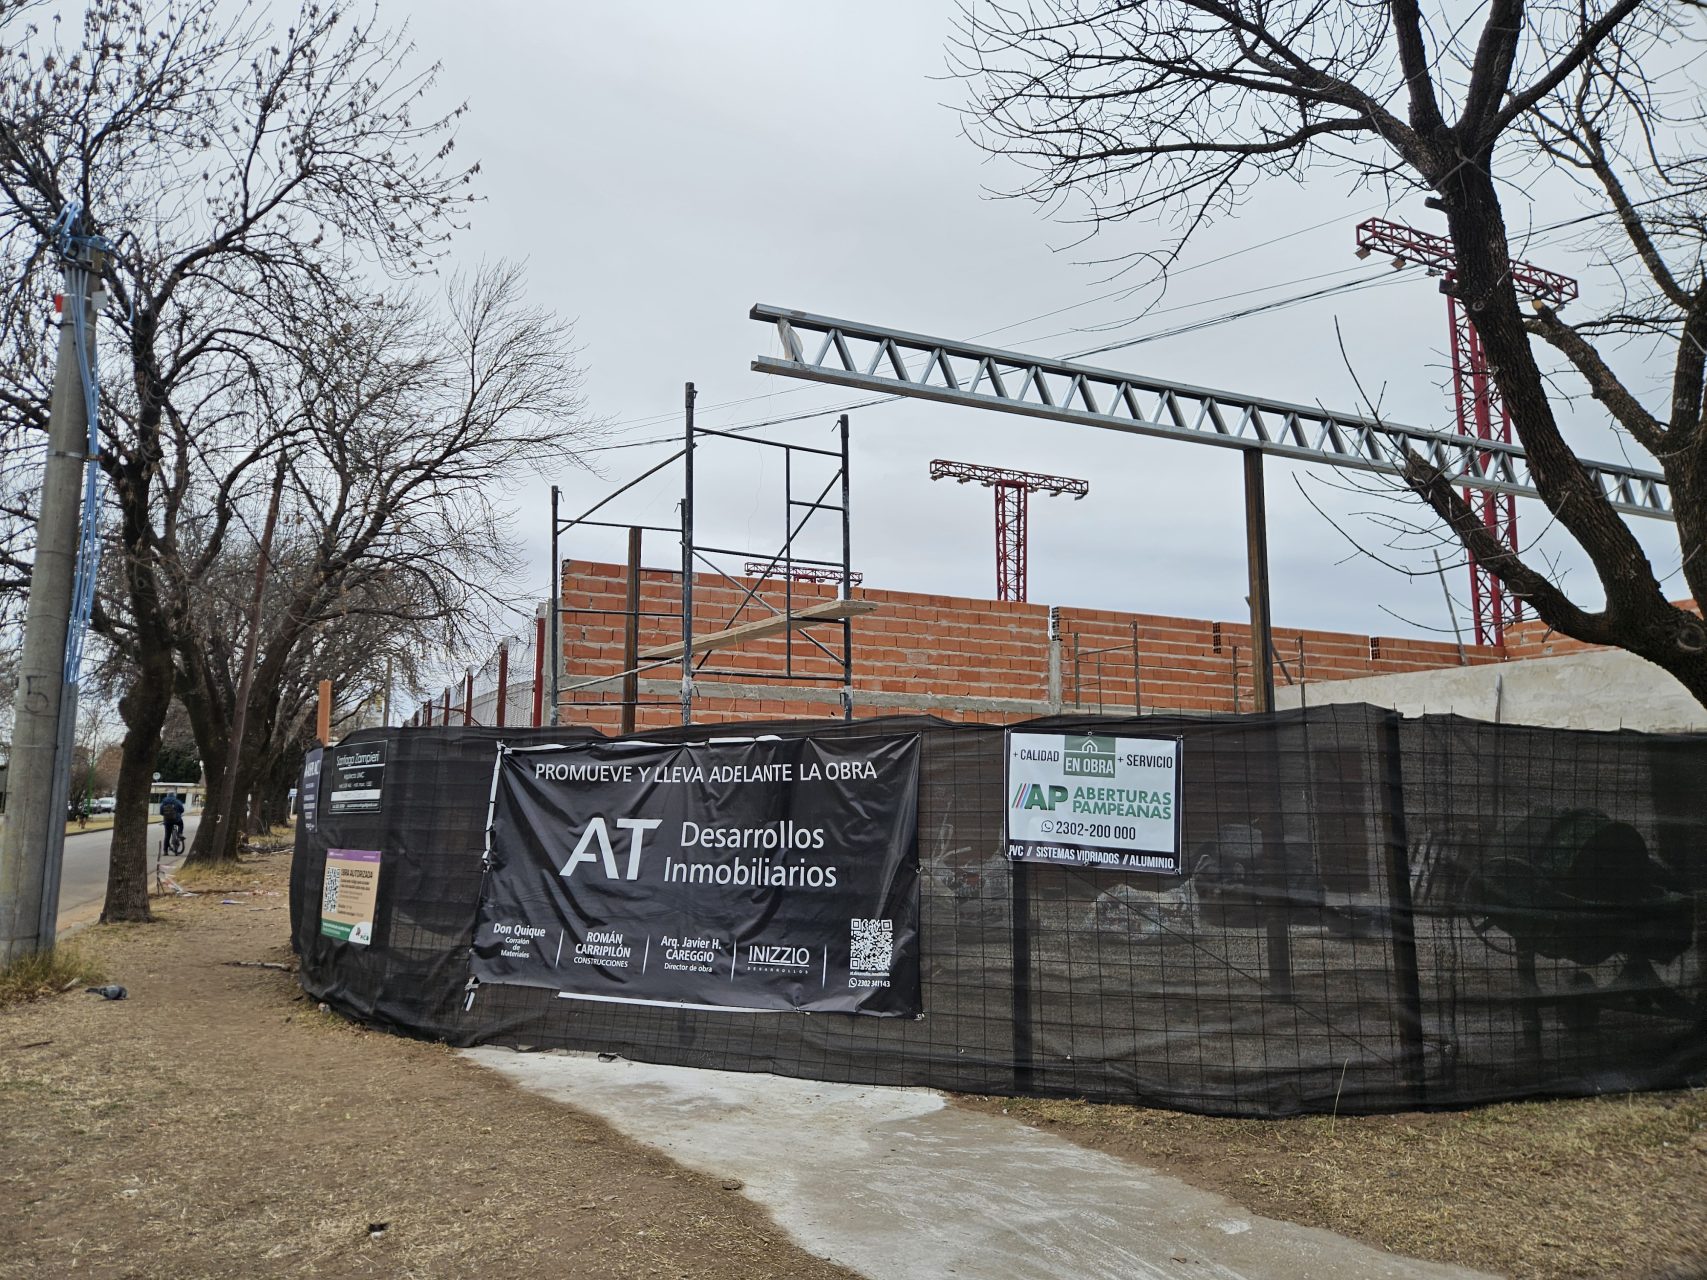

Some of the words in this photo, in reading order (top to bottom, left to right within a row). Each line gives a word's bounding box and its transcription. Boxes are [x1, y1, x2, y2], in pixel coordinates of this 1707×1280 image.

[1020, 749, 1060, 762] CALIDAD
[1126, 754, 1173, 768] SERVICIO
[535, 763, 632, 783] PROMUEVE
[637, 766, 651, 783] Y
[653, 766, 703, 783] LLEVA
[709, 764, 792, 783] ADELANTE
[799, 763, 822, 781] LA
[825, 761, 877, 780] OBRA
[1065, 758, 1080, 772] EN
[1084, 758, 1114, 774] OBRA
[1024, 783, 1069, 811] AP
[1073, 786, 1172, 805] ABERTURAS
[1072, 800, 1172, 820] PAMPEANAS
[680, 820, 824, 849] Desarrollos
[1055, 821, 1111, 838] 2302-200
[1114, 825, 1136, 840] 000
[559, 817, 663, 880] AT
[1036, 846, 1075, 860] SISTEMAS
[1077, 849, 1119, 865] VIDRIADOS
[1129, 855, 1174, 869] ALUMINIO
[664, 856, 837, 887] Inmobiliarios
[493, 922, 512, 934] Don
[513, 924, 546, 938] Quique
[586, 930, 623, 944] ROMÁN
[505, 936, 530, 945] Corralón
[512, 943, 521, 951] de
[660, 935, 680, 949] Arq.
[681, 936, 710, 949] Javier
[712, 938, 722, 950] H.
[500, 949, 530, 959] Materiales
[575, 943, 631, 958] CARRIPILÓN
[665, 948, 714, 963] CAREGGIO
[748, 945, 810, 965] INIZZIO
[573, 956, 628, 968] CONSTRUCCIONES
[664, 962, 688, 971] Director
[689, 964, 698, 972] de
[698, 965, 713, 973] obra
